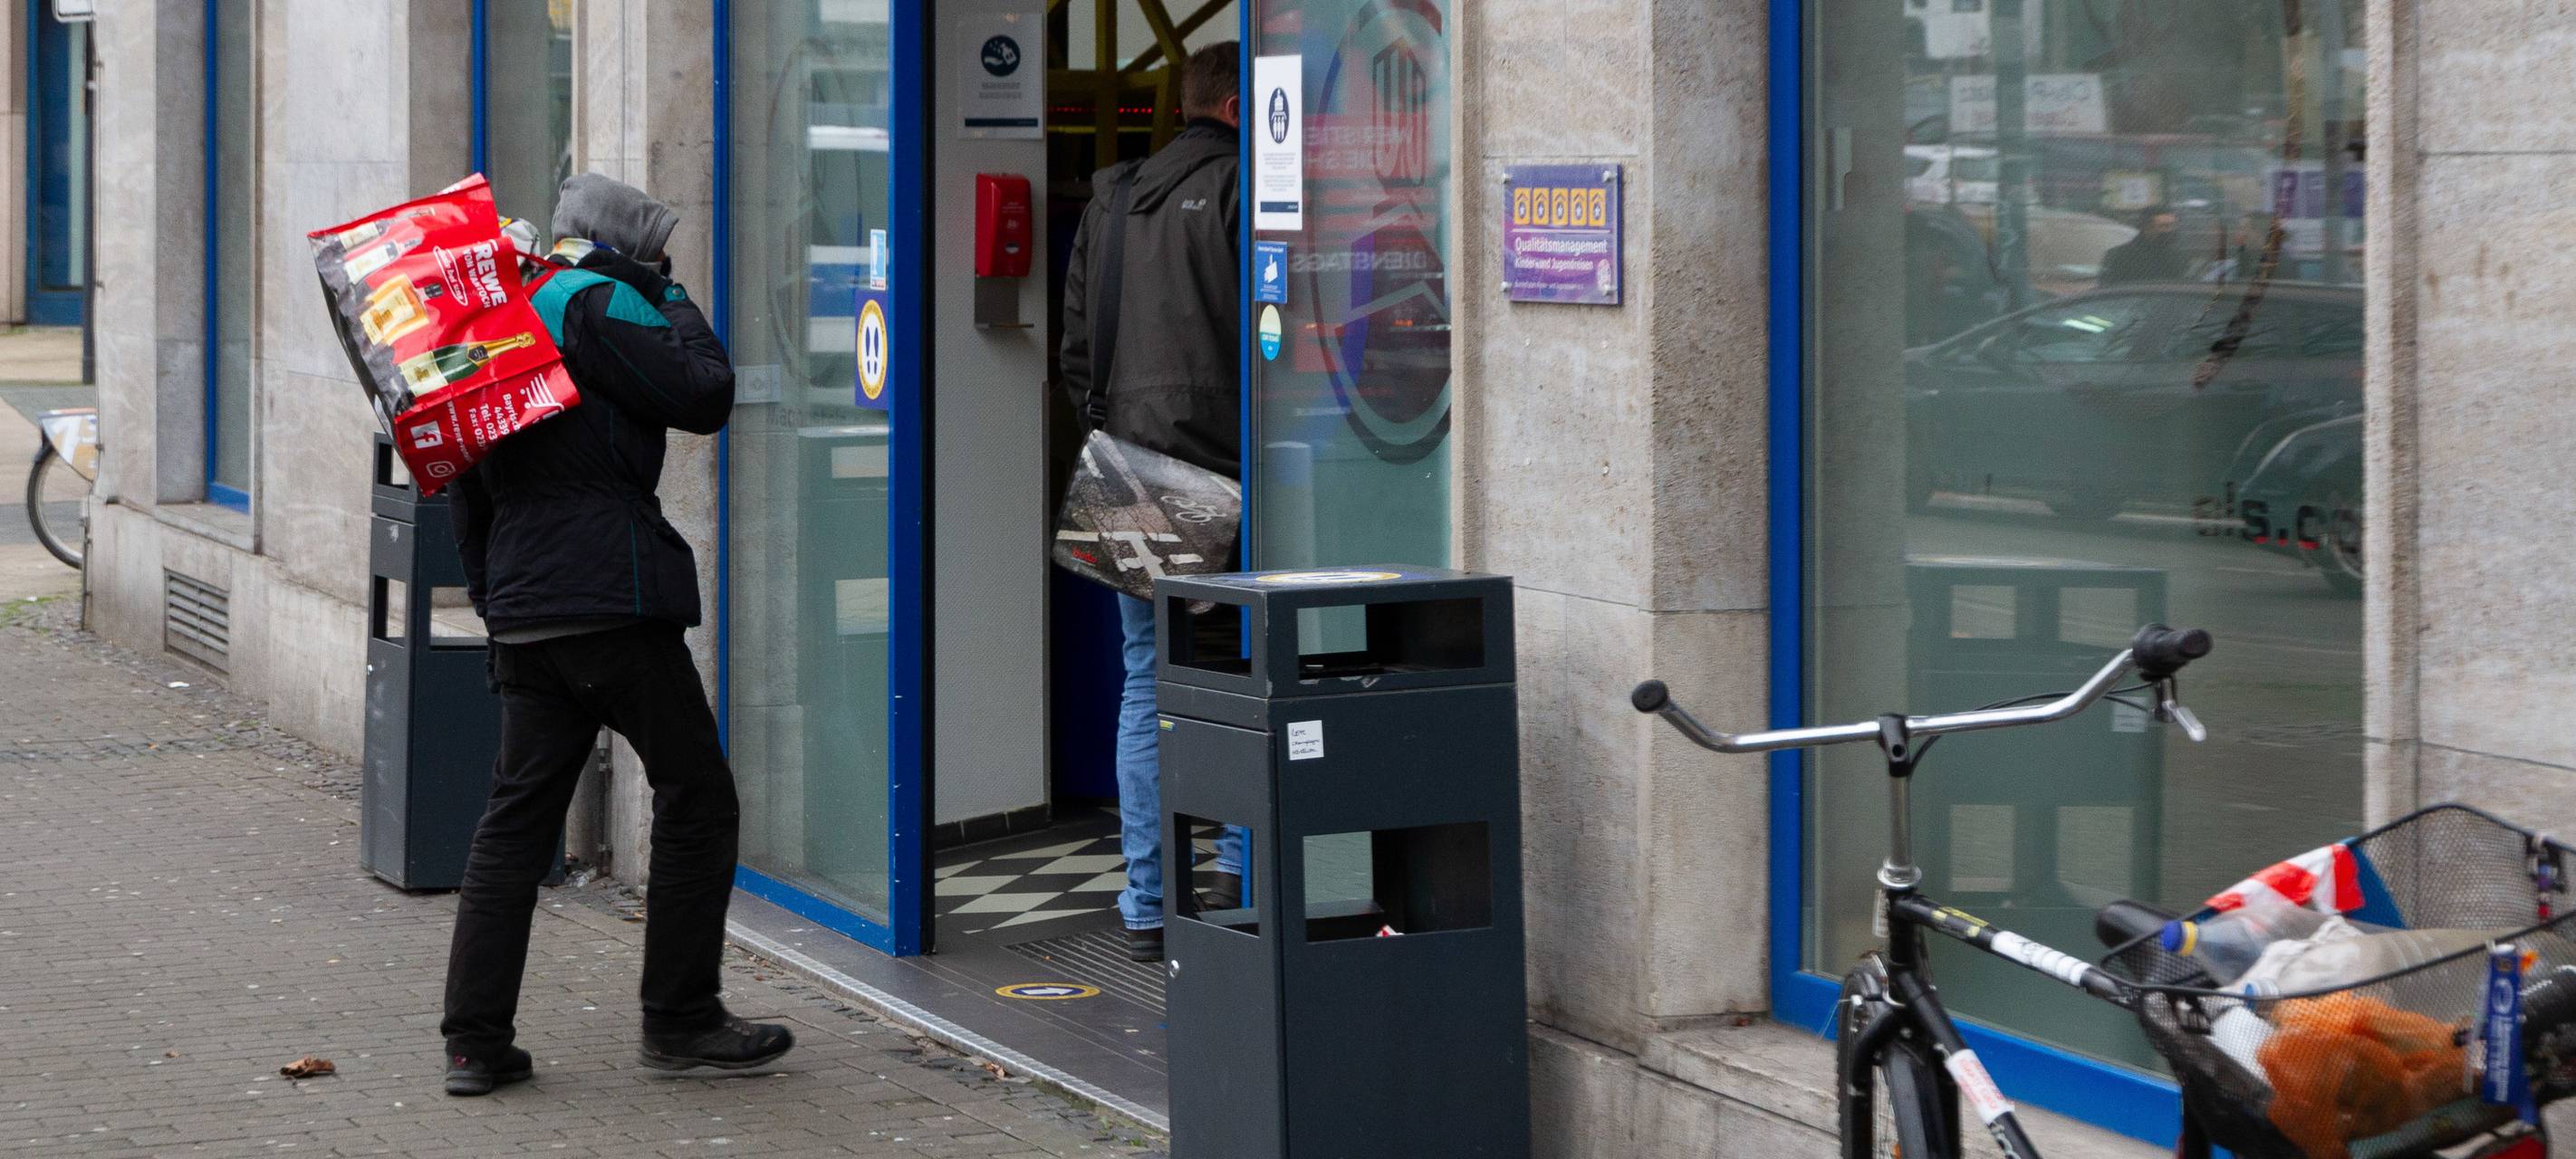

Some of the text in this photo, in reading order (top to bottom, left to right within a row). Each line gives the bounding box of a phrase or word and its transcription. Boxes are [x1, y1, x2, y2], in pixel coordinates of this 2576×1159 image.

[1514, 236, 1608, 256] Qualitätsmanagement
[473, 242, 508, 307] REWE
[1551, 258, 1594, 273] Jugendreisen
[467, 268, 491, 308] WANTOCH
[468, 408, 480, 427] Fax:
[480, 403, 492, 422] Tel:
[494, 407, 510, 436] 44339
